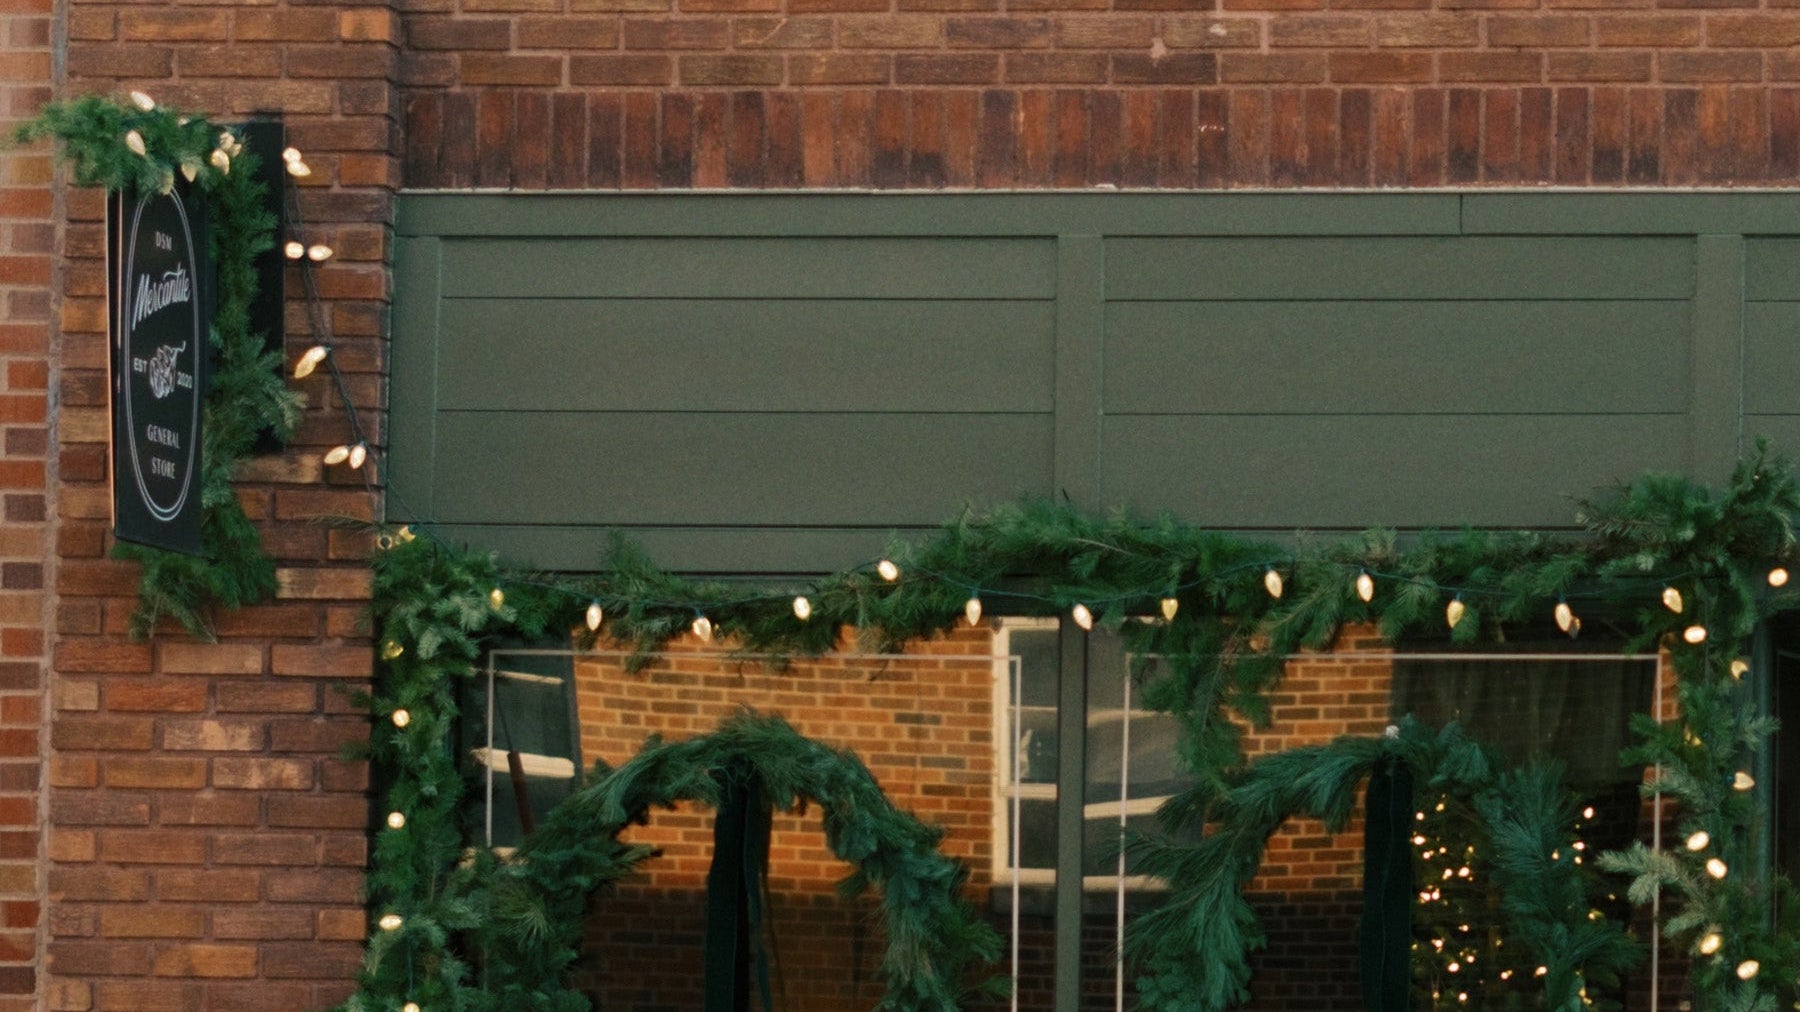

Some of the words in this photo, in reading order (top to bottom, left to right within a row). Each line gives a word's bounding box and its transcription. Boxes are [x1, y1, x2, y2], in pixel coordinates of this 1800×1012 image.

[155, 231, 173, 252] DSM
[132, 261, 191, 332] Mercantile
[133, 357, 148, 373] EST
[177, 371, 193, 389] 2020
[147, 423, 180, 449] GENERAL
[152, 456, 176, 480] STORE
